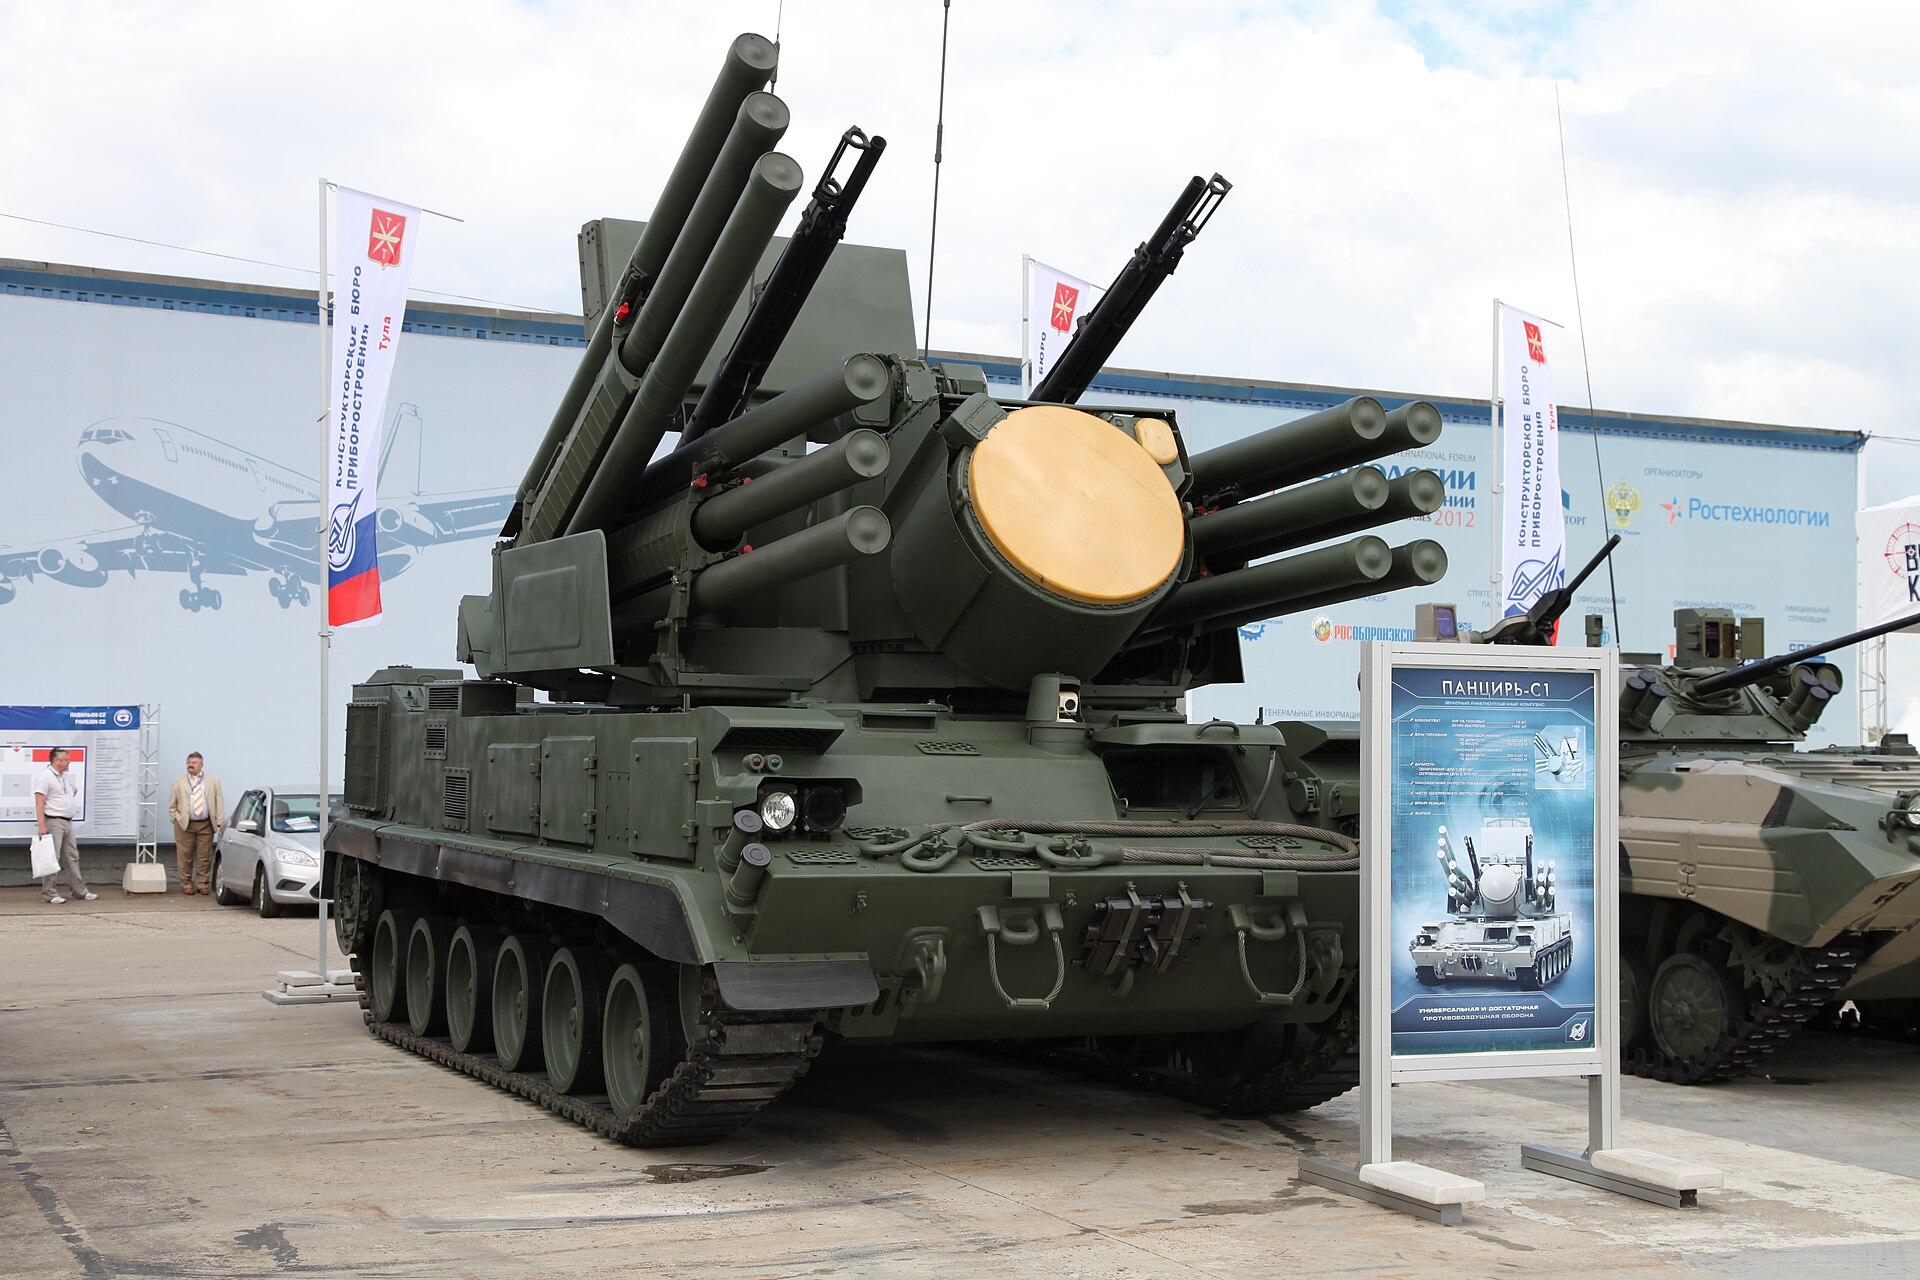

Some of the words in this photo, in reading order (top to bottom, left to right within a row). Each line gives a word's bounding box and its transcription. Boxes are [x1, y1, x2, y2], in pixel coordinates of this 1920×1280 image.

[350, 265, 362, 315] БЮРО
[378, 316, 392, 351] Тула
[1038, 331, 1047, 375] БЮРО
[1521, 365, 1531, 406] БЮРО
[346, 324, 370, 490] ПРИБОРОСТРОЕНИЯ
[1548, 403, 1556, 431] Тула
[1449, 452, 1477, 463] FORUM
[1643, 467, 1704, 479] ОРГАНИЗАТОРЫ
[1518, 413, 1532, 547] КОНСТРУКТОРСКОЕ
[1531, 411, 1545, 548] ПРИБОРОСТРОЕНИЯ
[1434, 509, 1475, 528] 2012
[1688, 497, 1830, 527] Ростехнологии
[1442, 680, 1550, 700] ПАНЦИРЬ-С1
[1264, 709, 1314, 718] ГЕНЕРАЛЬНЫЕ
[1315, 710, 1361, 719] ИНФОРМАЦИ
